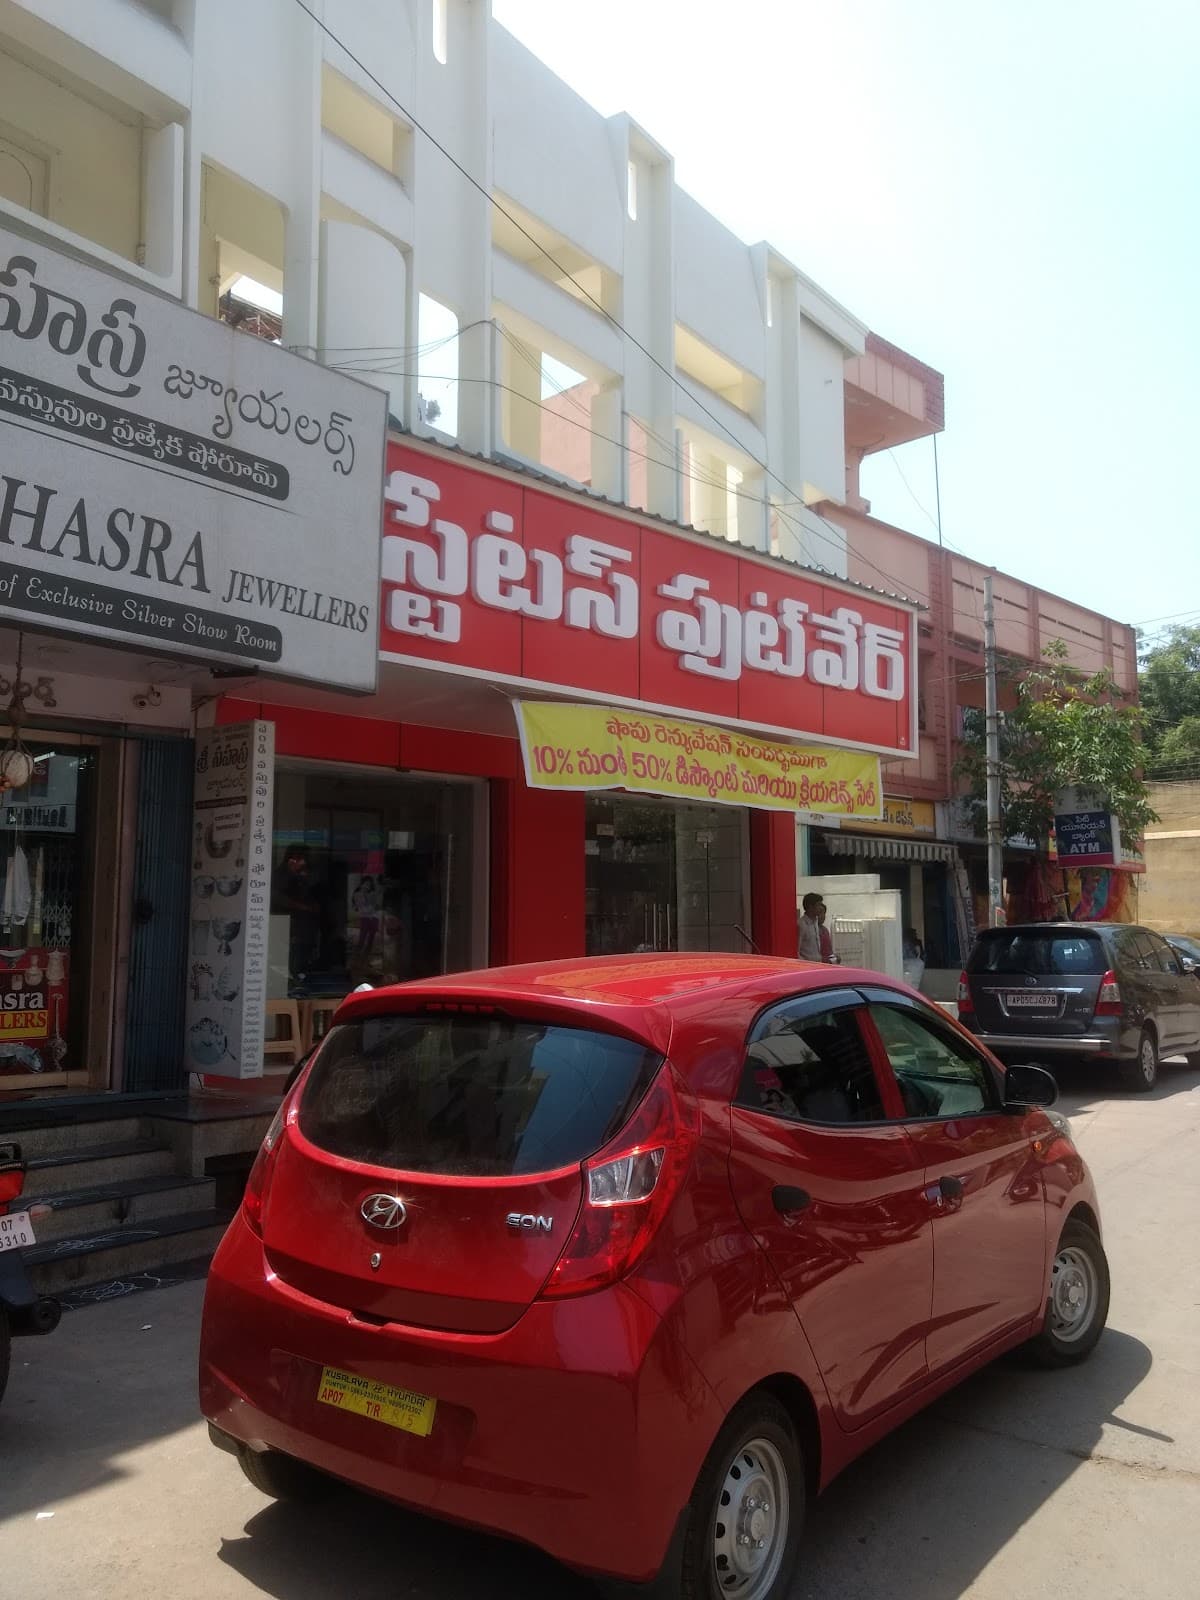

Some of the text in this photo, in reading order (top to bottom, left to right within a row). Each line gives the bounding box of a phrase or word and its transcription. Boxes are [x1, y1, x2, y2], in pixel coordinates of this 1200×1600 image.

[111, 417, 184, 459] ప్రత్యేక
[0, 475, 369, 633] HASRA JEWELLERS
[0, 574, 278, 651] of Exclusive Silver Show Room
[533, 745, 573, 775] 10%
[632, 752, 672, 783] 50%
[1070, 842, 1100, 854] ATM
[1, 1219, 12, 1232] 07
[506, 1213, 553, 1231] EON
[321, 1387, 344, 1405] AP07
